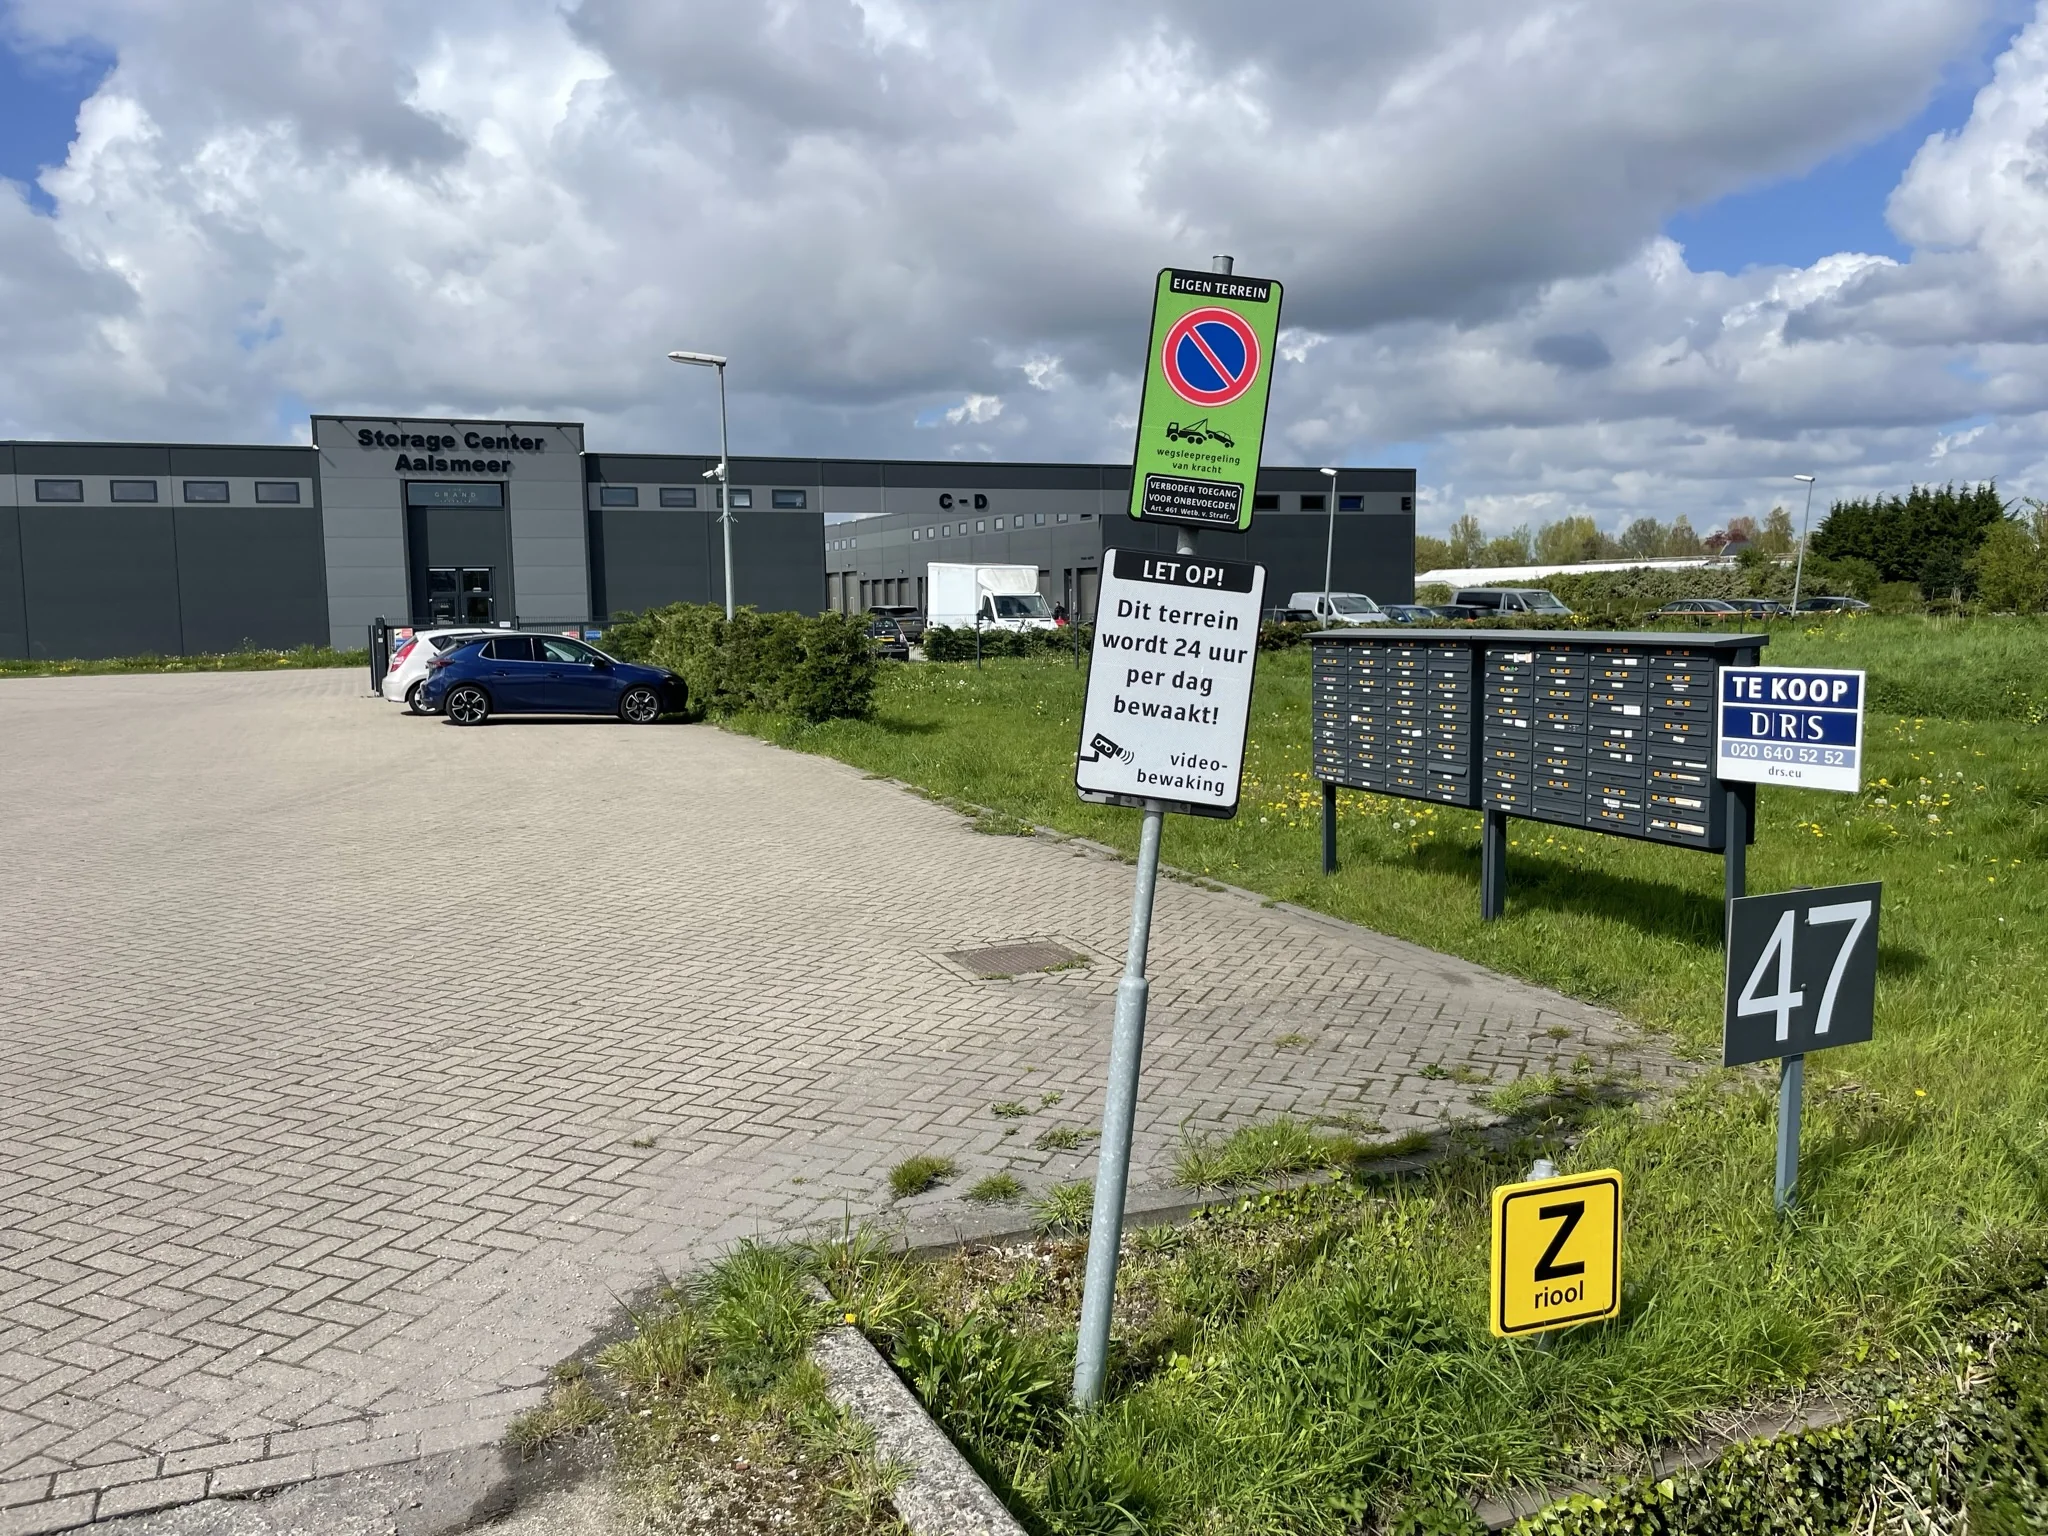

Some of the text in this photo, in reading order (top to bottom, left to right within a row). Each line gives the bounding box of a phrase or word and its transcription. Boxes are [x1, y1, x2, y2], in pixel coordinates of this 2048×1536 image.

[1173, 278, 1267, 300] EIGEN TERREIN
[358, 428, 545, 452] Storage Center
[395, 453, 511, 473] Aalsmeer
[1156, 448, 1241, 466] wegsleepregeling
[1172, 462, 1222, 474] van kracht
[1150, 481, 1238, 498] VERBODEN TOEGANG
[939, 493, 953, 509] C
[974, 493, 988, 509] D
[1148, 493, 1236, 511] VOOR ONBEVOEGDEN
[1150, 504, 1164, 512] Art.
[1165, 506, 1178, 514] 461
[1180, 508, 1200, 517] Wetb.
[1209, 511, 1231, 520] Strafr.
[1401, 496, 1412, 511] E
[1142, 559, 1225, 587] LET OP!
[1117, 599, 1240, 631] Dit terrein
[1102, 633, 1248, 664] wordt 24 uur
[1126, 668, 1213, 697] per dag
[1732, 676, 1848, 703] TE KOOP
[1113, 695, 1219, 725] bewaakt!
[1170, 753, 1228, 772] video-
[1730, 743, 1844, 765] 020 640 52 52
[1137, 768, 1225, 797] bewaking
[1768, 765, 1802, 778] drs.eu
[1737, 900, 1873, 1042] 47
[1533, 1199, 1586, 1283] Z
[1534, 1279, 1585, 1310] riool
